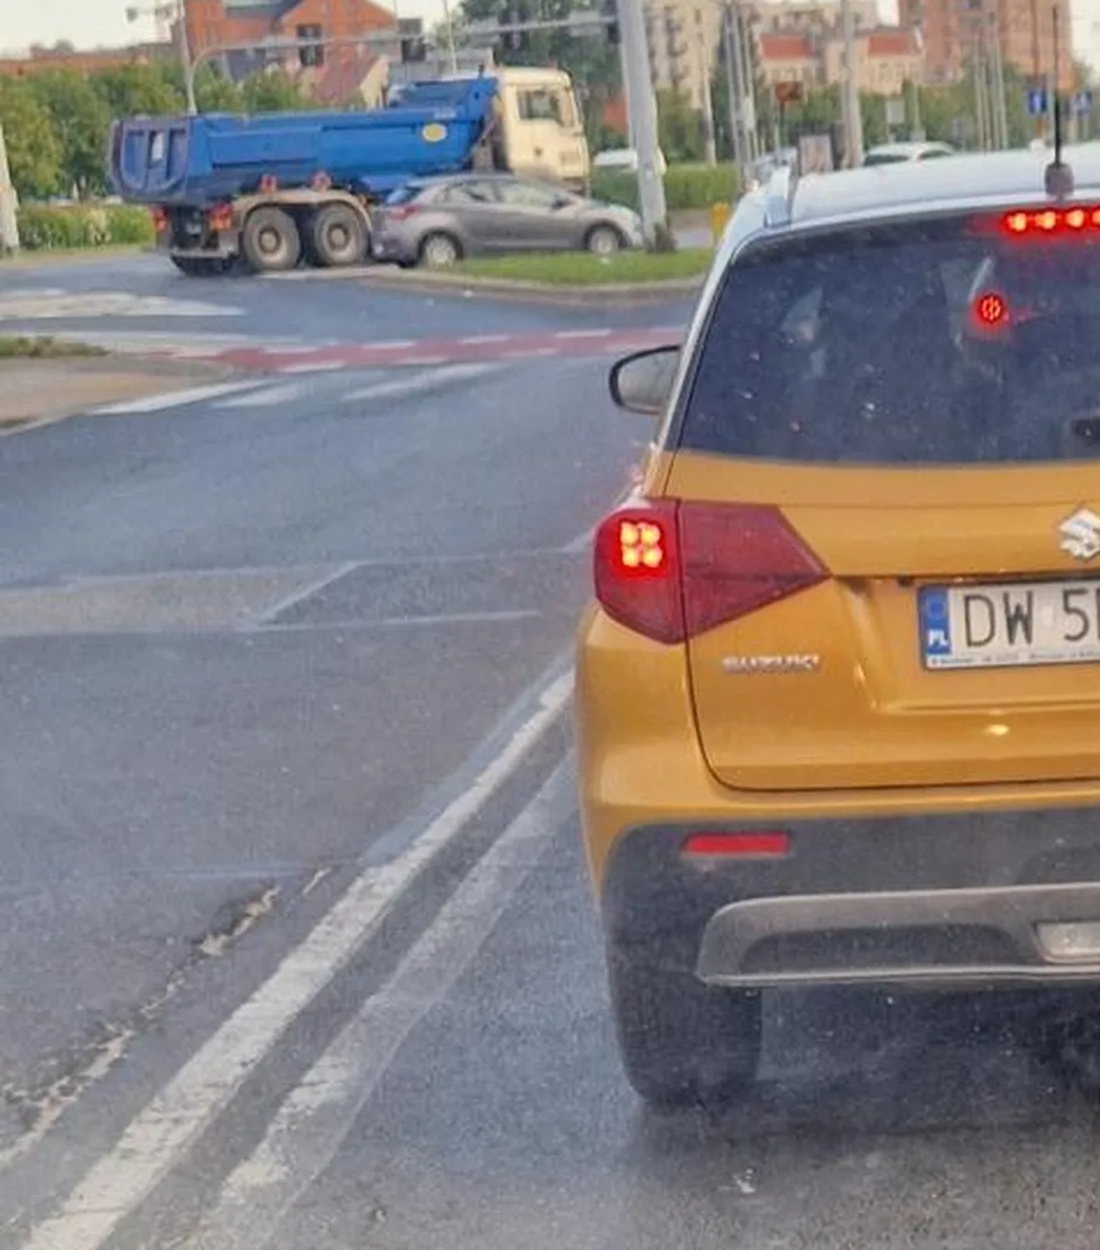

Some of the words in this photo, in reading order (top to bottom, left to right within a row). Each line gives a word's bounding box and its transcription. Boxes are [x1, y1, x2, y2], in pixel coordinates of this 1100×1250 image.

[963, 591, 1034, 648] DW
[928, 629, 949, 647] PL
[722, 654, 819, 674] SUZUKI
